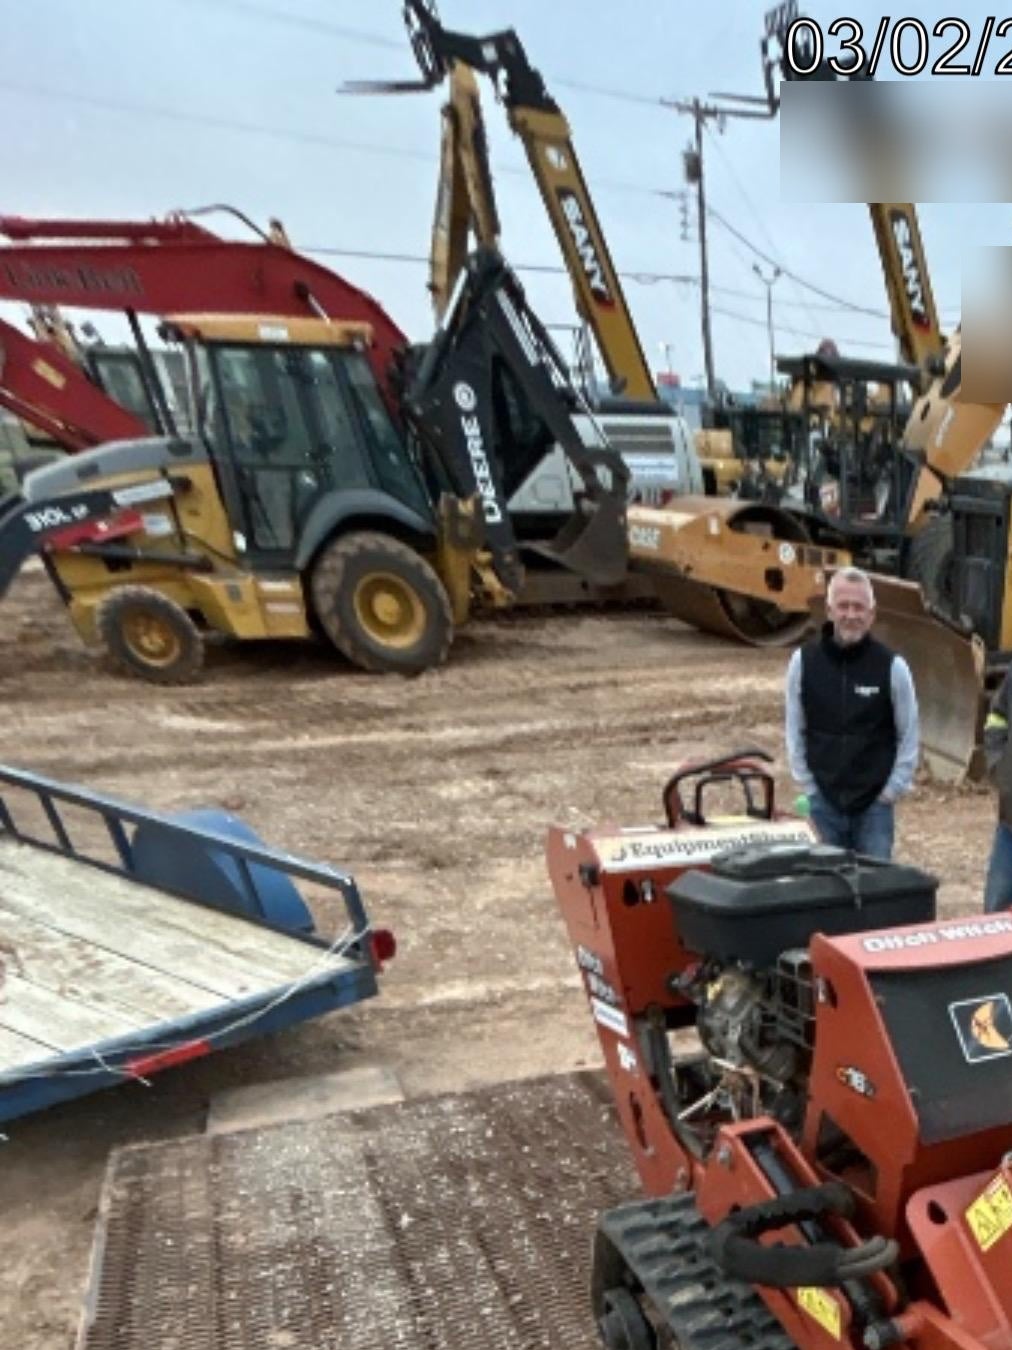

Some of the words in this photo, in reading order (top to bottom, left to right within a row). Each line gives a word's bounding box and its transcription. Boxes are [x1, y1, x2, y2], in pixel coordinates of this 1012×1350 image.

[560, 194, 609, 292] SANY
[892, 216, 926, 313] SANY
[460, 414, 503, 524] DEERE
[862, 930, 938, 953] Ditch
